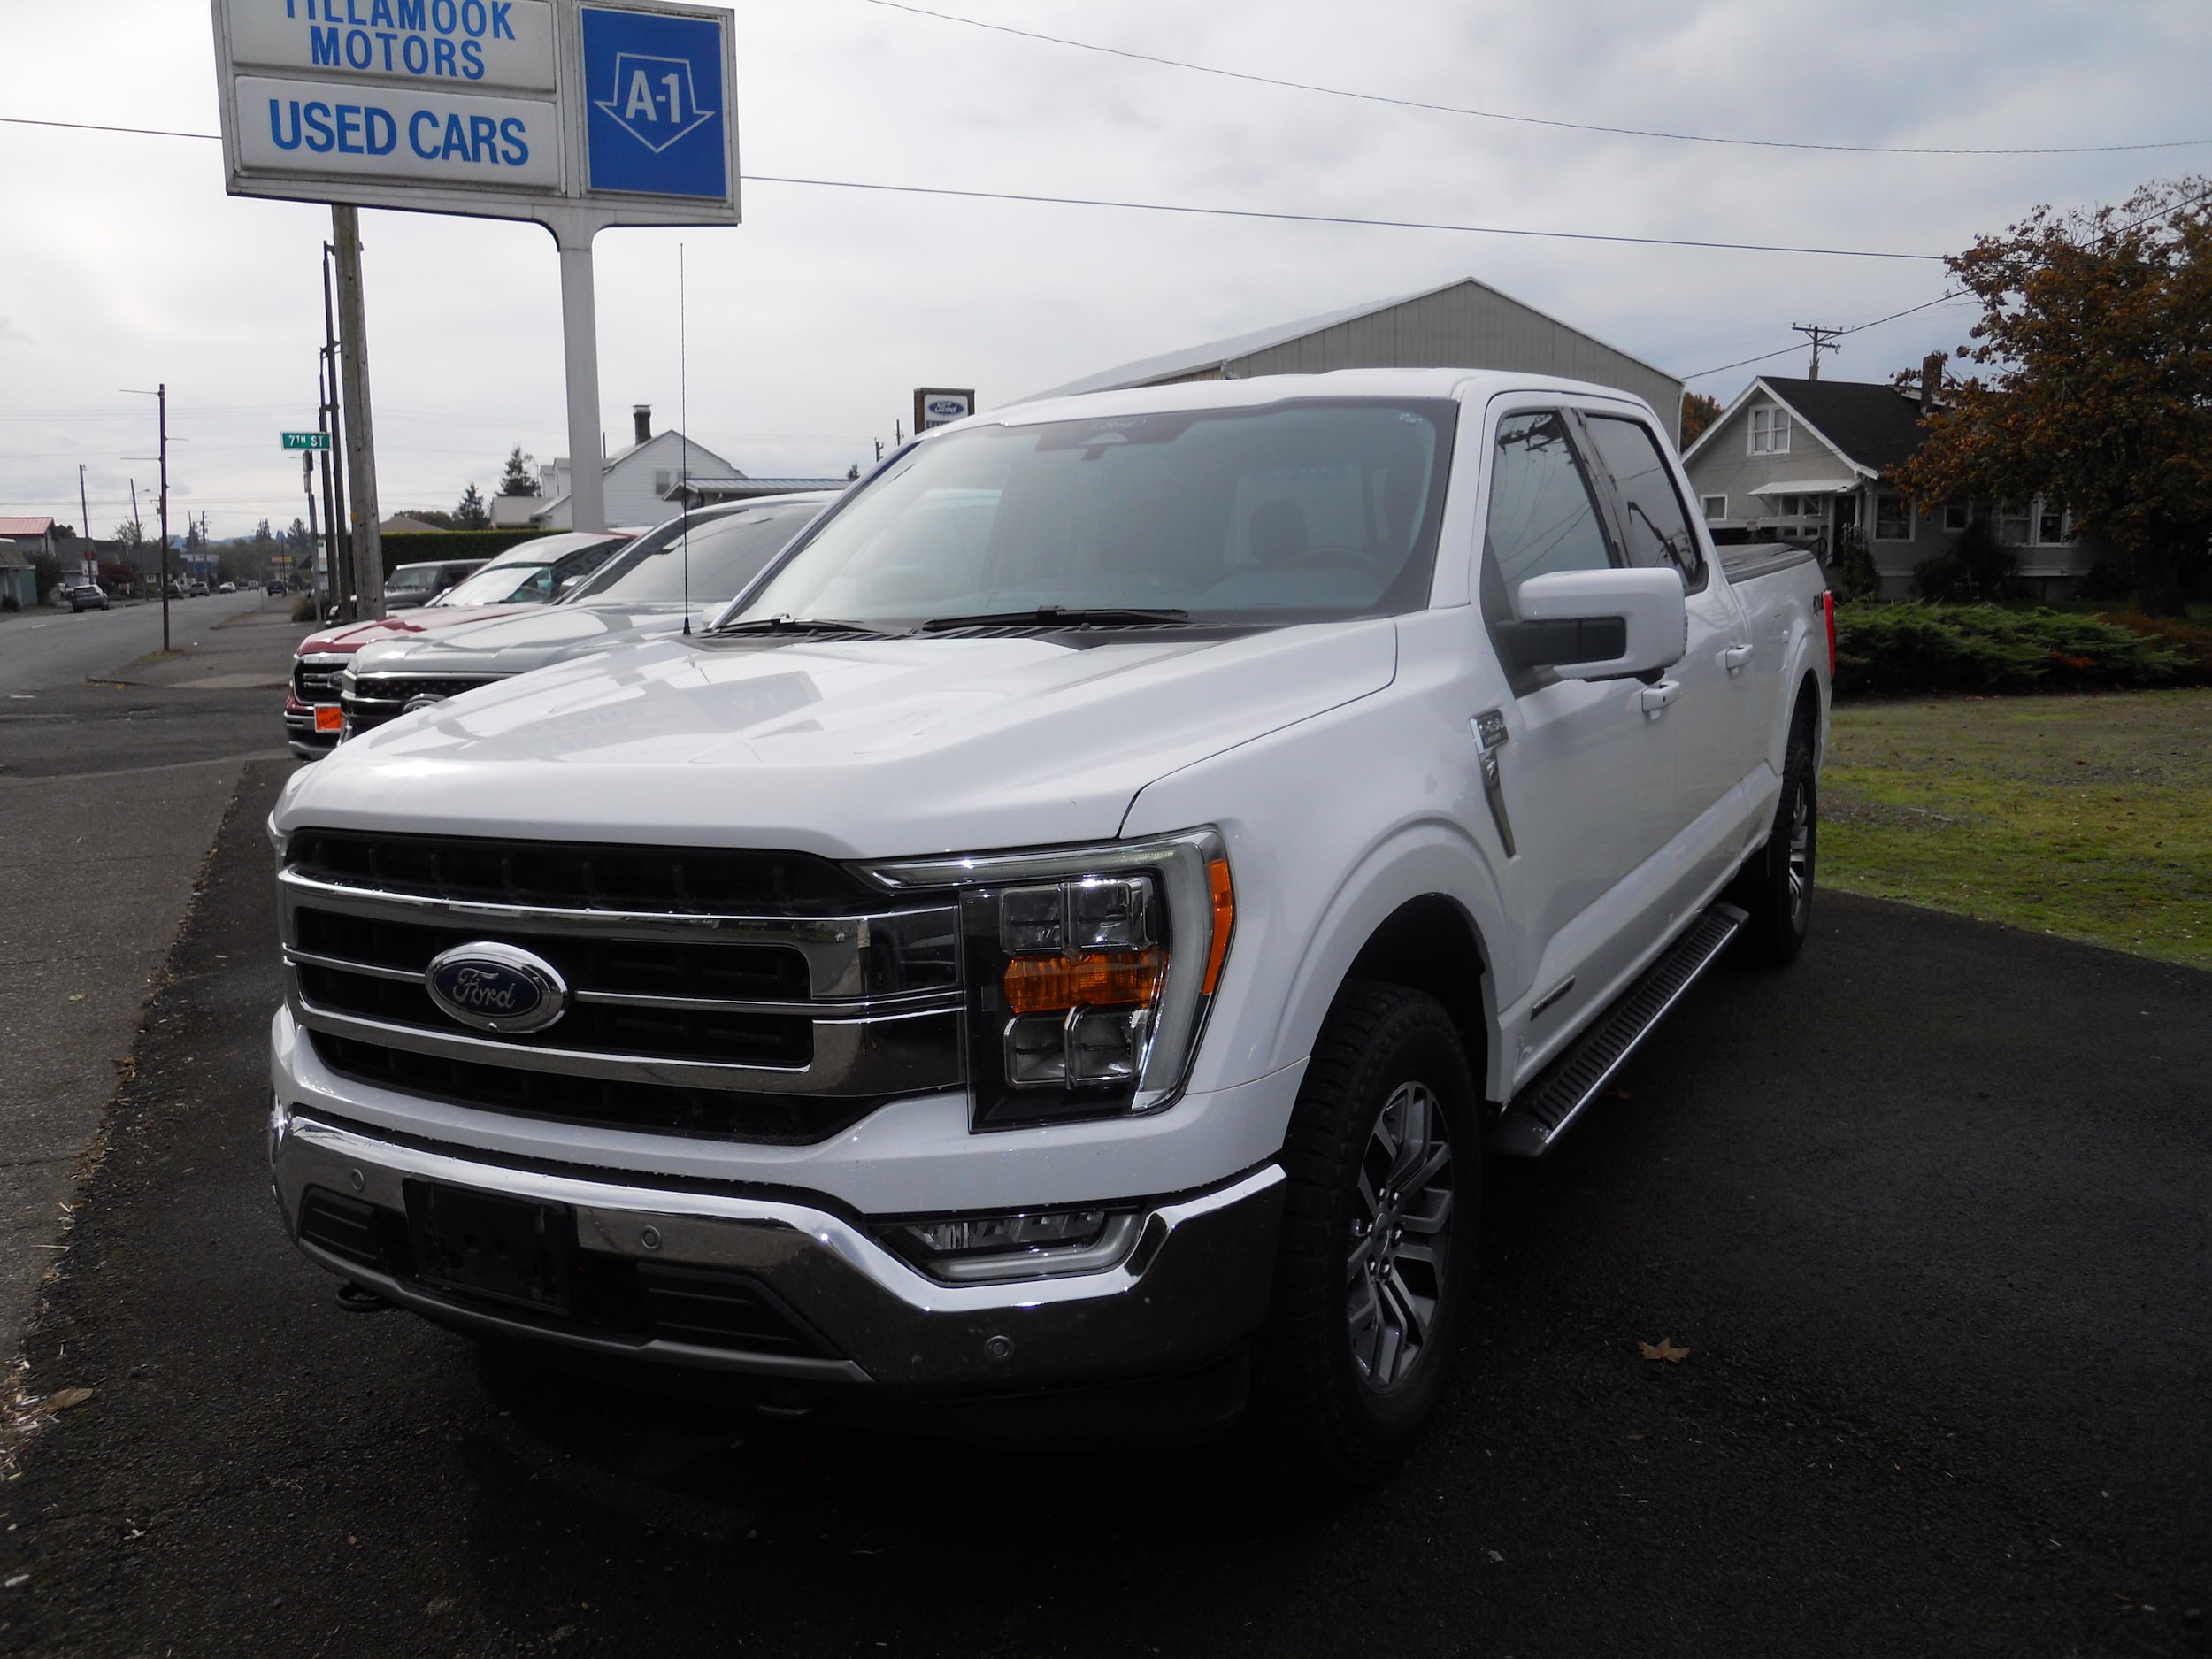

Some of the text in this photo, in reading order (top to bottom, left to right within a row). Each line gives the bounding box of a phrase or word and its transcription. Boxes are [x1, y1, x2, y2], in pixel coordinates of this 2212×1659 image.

[311, 26, 485, 80] MOTORS
[626, 70, 680, 123] A-1
[269, 99, 529, 166] USED CARS
[934, 403, 957, 414] Ford
[288, 435, 323, 448] 7TH ST
[453, 967, 515, 1009] Ford
